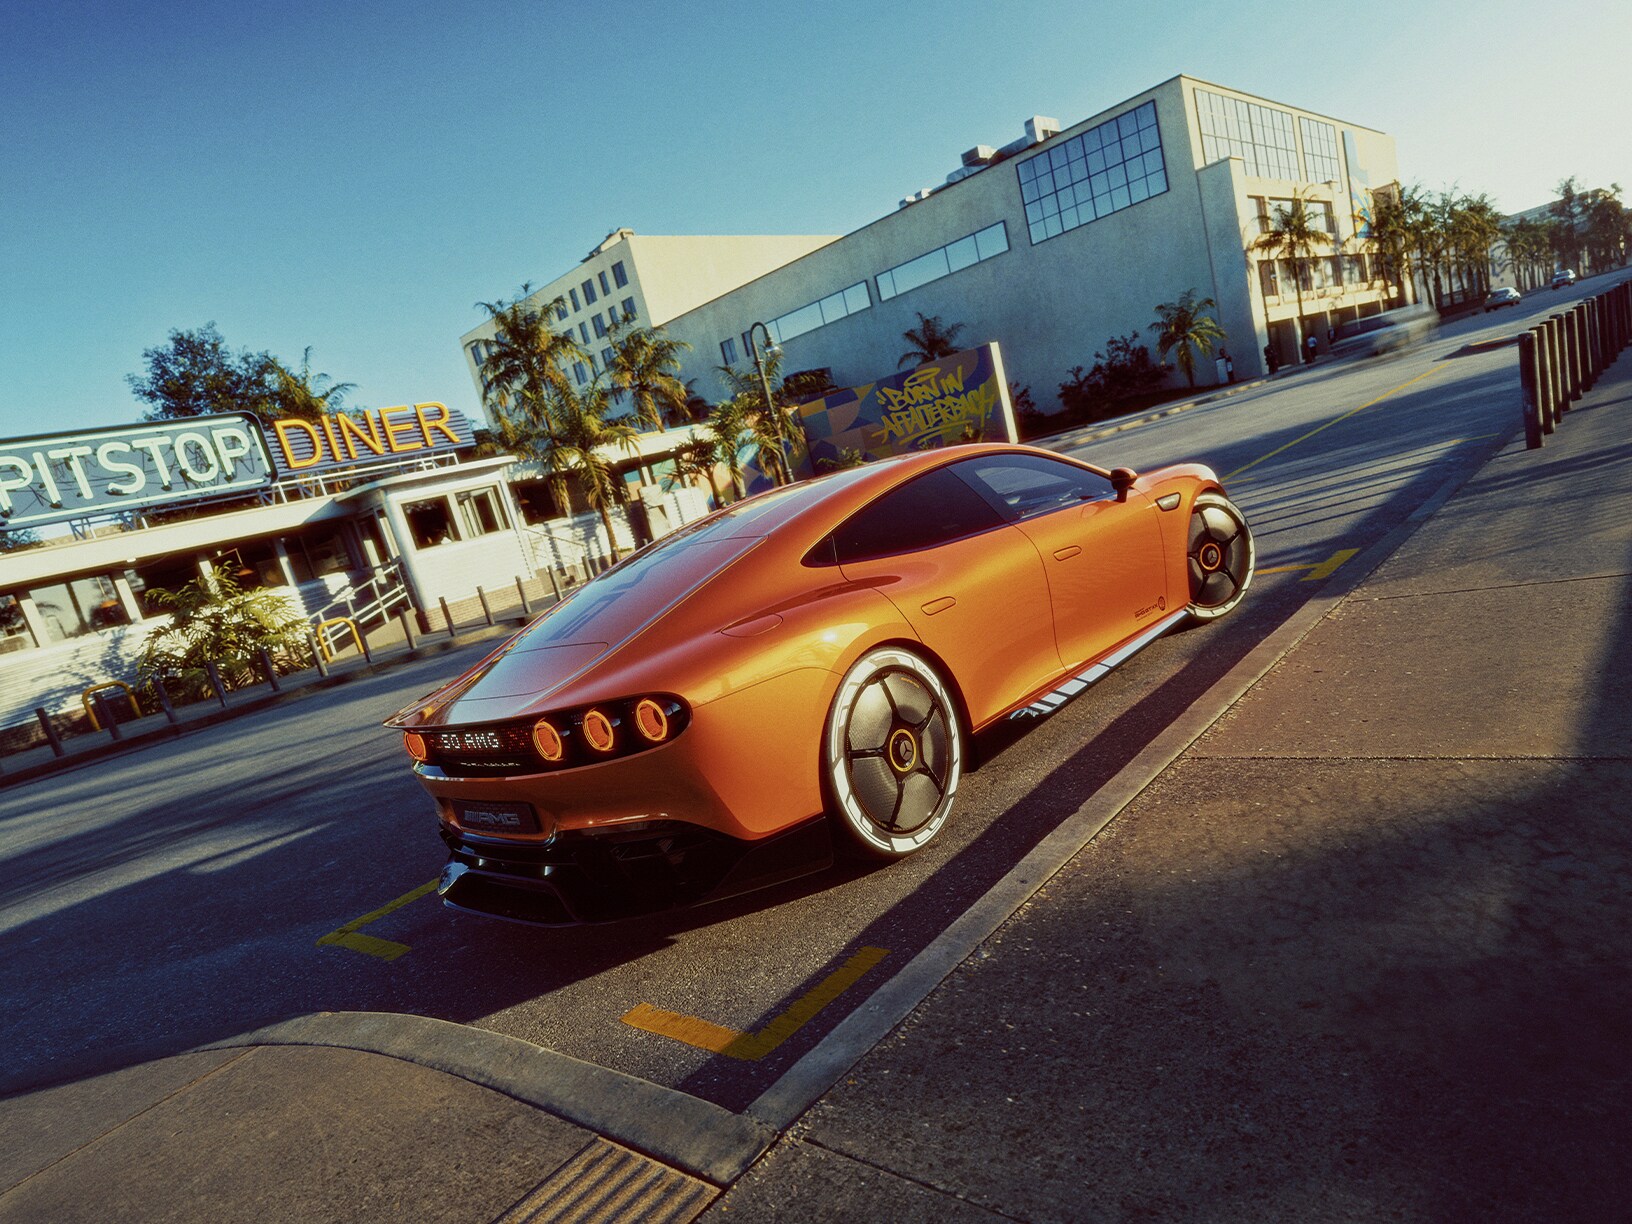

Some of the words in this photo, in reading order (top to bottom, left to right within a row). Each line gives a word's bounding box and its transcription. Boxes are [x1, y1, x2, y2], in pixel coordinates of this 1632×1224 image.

[941, 365, 964, 394] IN
[0, 428, 250, 512] PITSTOP
[273, 401, 461, 469] DINER
[465, 732, 499, 749] AMG
[479, 811, 520, 826] AMG
